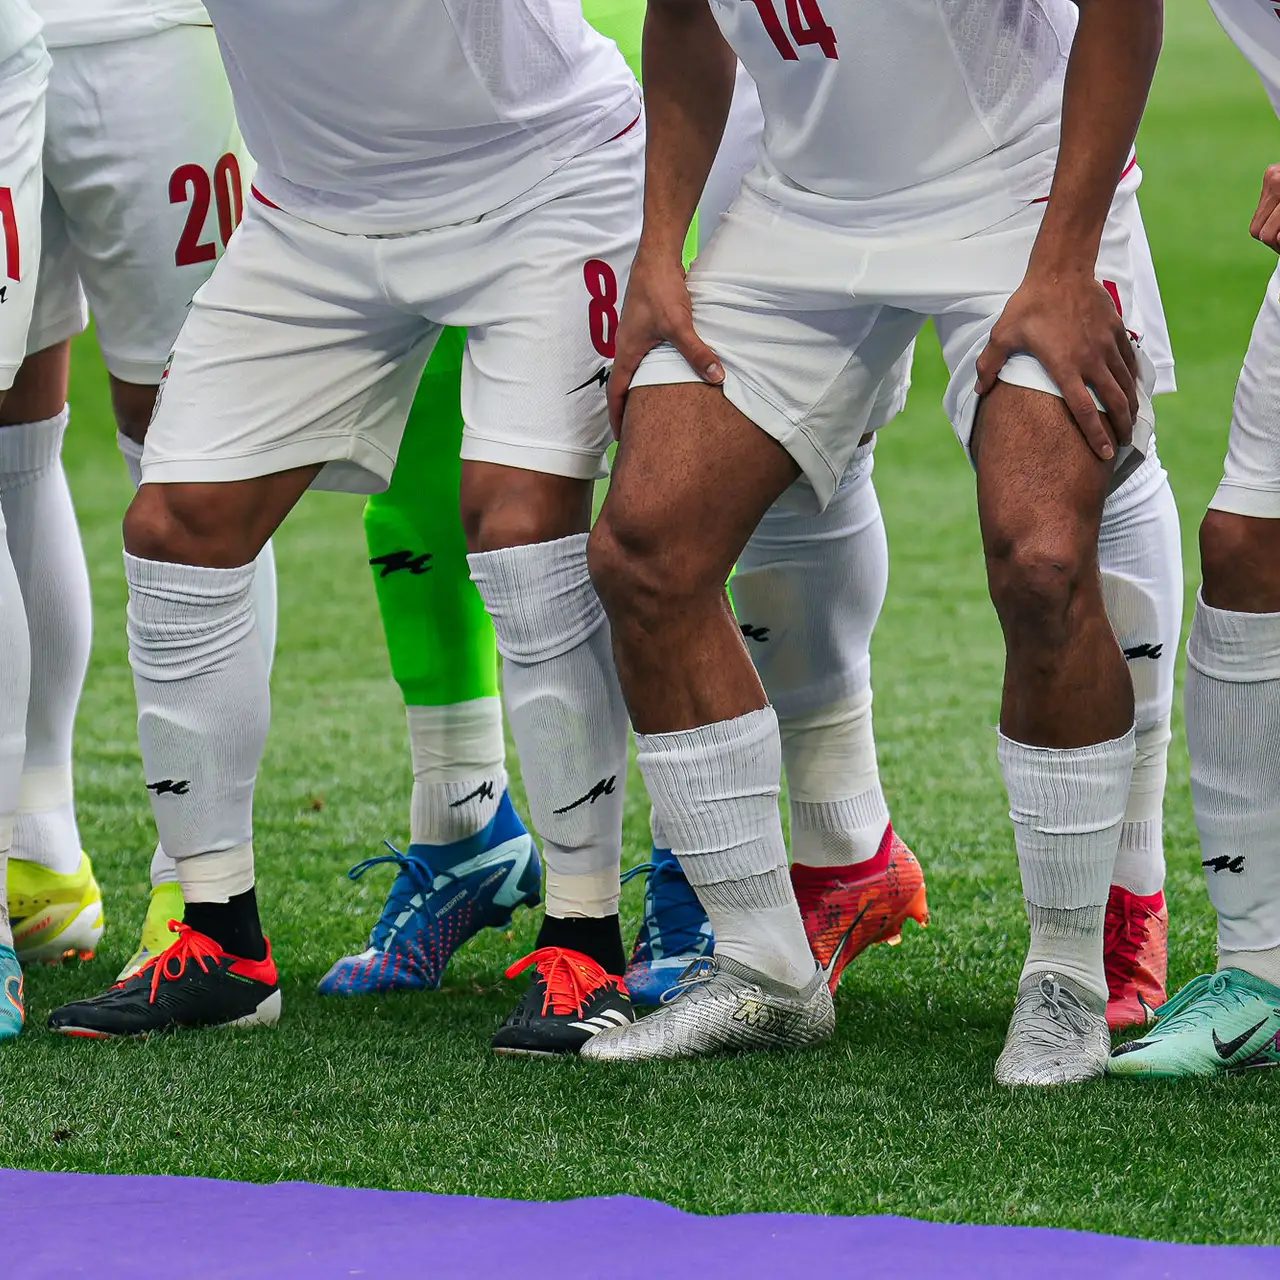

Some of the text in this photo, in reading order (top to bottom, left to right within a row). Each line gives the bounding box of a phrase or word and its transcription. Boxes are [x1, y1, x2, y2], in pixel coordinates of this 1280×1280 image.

[169, 153, 243, 267] 20
[583, 259, 619, 359] 8
[434, 888, 469, 920] PREDATOR
